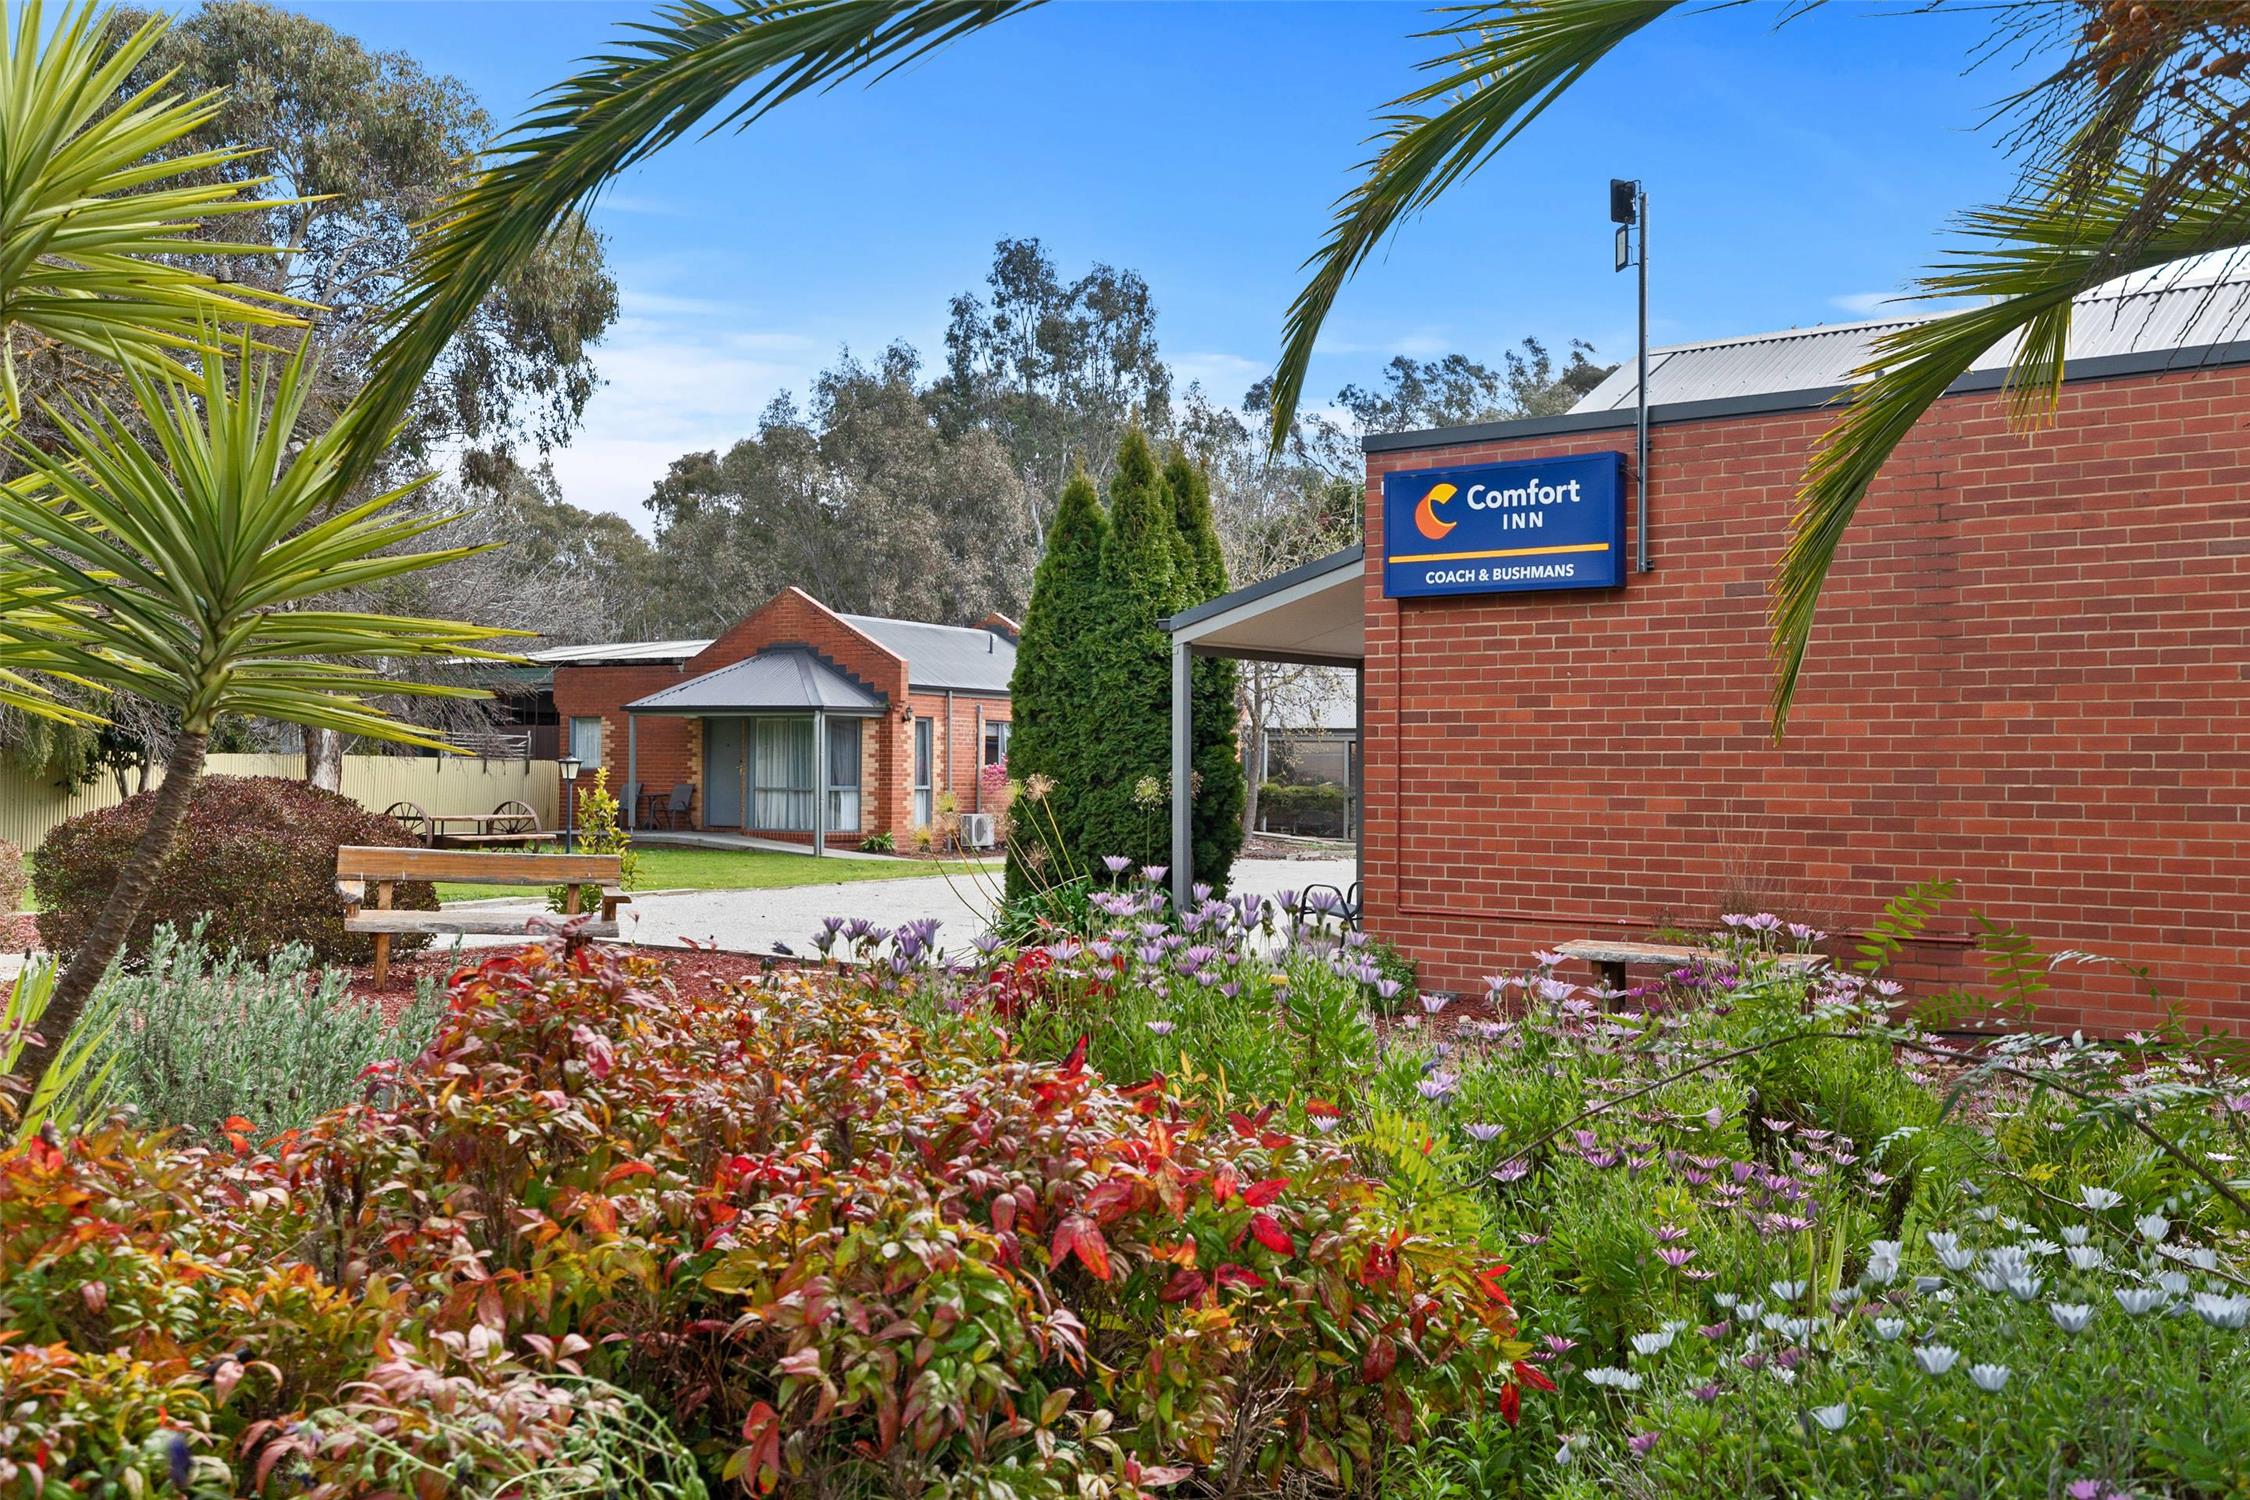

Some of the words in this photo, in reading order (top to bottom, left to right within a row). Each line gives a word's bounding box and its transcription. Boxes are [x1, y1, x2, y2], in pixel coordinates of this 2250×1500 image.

[1467, 478, 1580, 510] Comfort
[1503, 511, 1543, 530] INN
[1425, 569, 1475, 584] COACH
[1478, 568, 1489, 581] &
[1493, 563, 1574, 581] BUSHMANS
